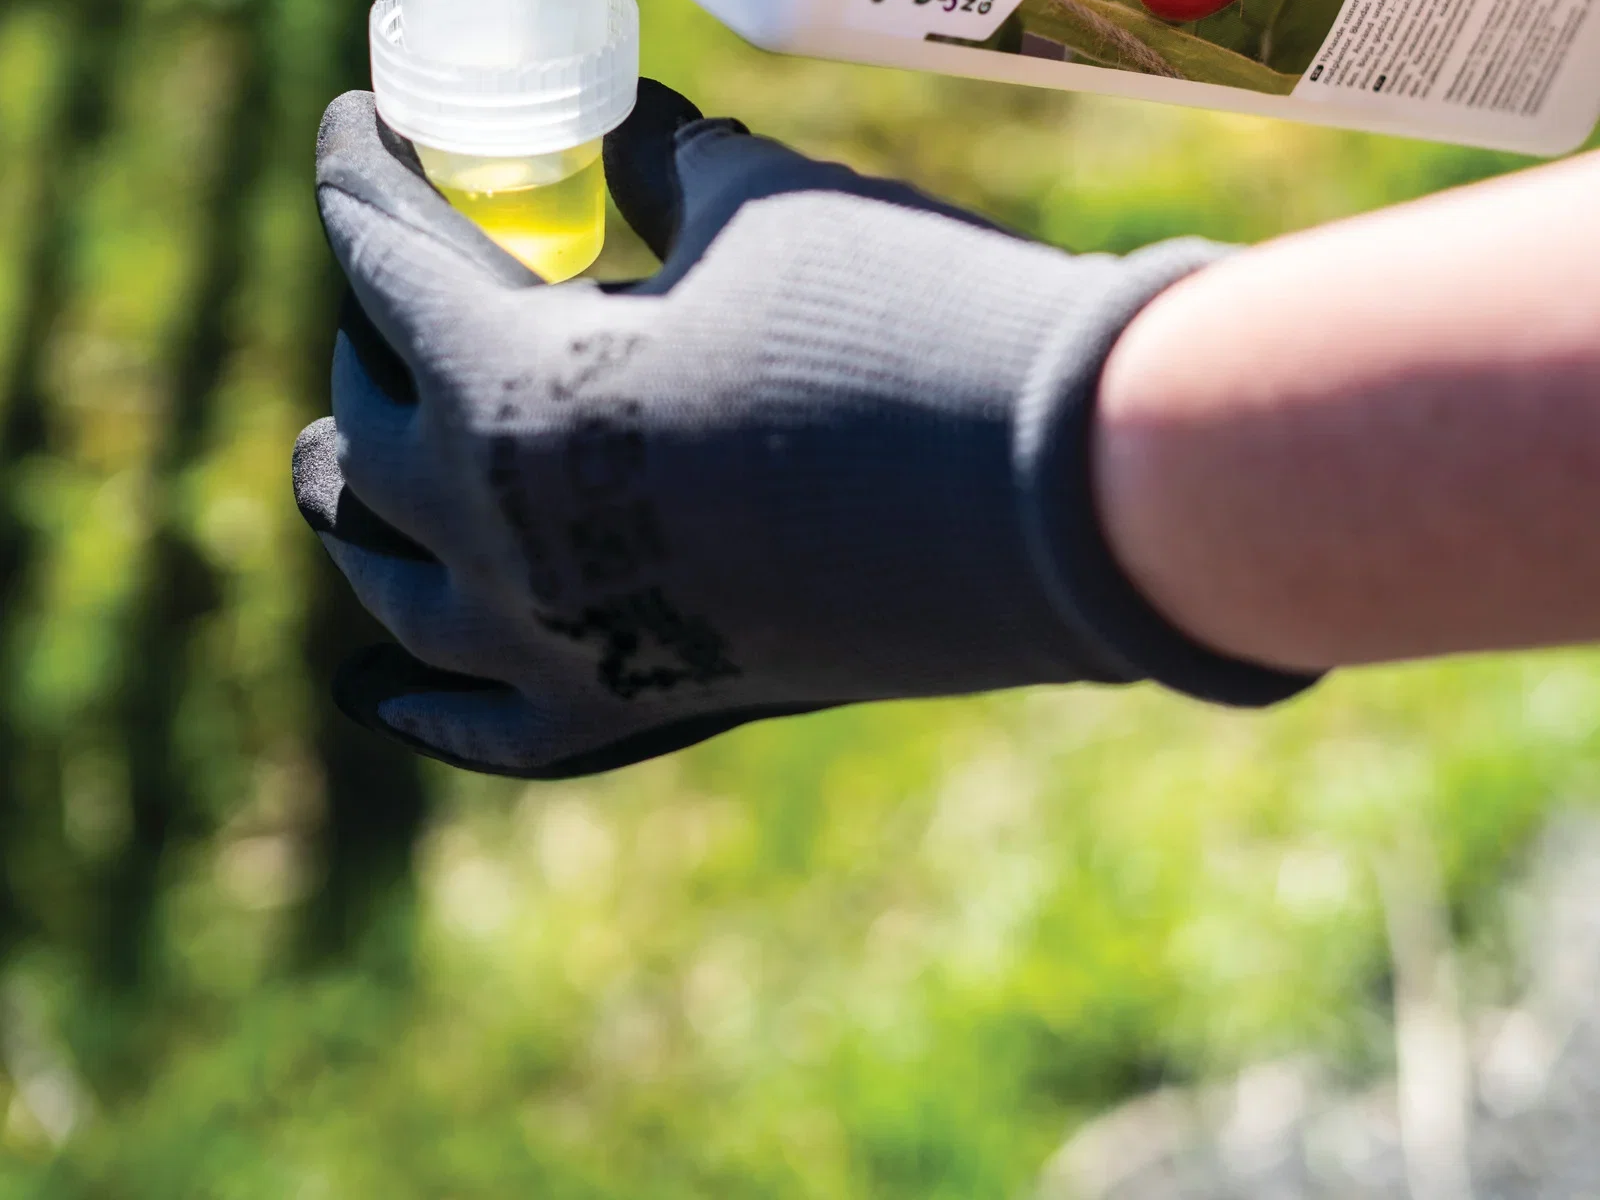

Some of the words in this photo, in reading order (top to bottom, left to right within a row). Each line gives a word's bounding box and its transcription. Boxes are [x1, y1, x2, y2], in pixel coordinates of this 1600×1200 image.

[1349, 0, 1372, 34] Blandas
[1321, 26, 1346, 63] Flytande
[1352, 21, 1375, 54] Använd
